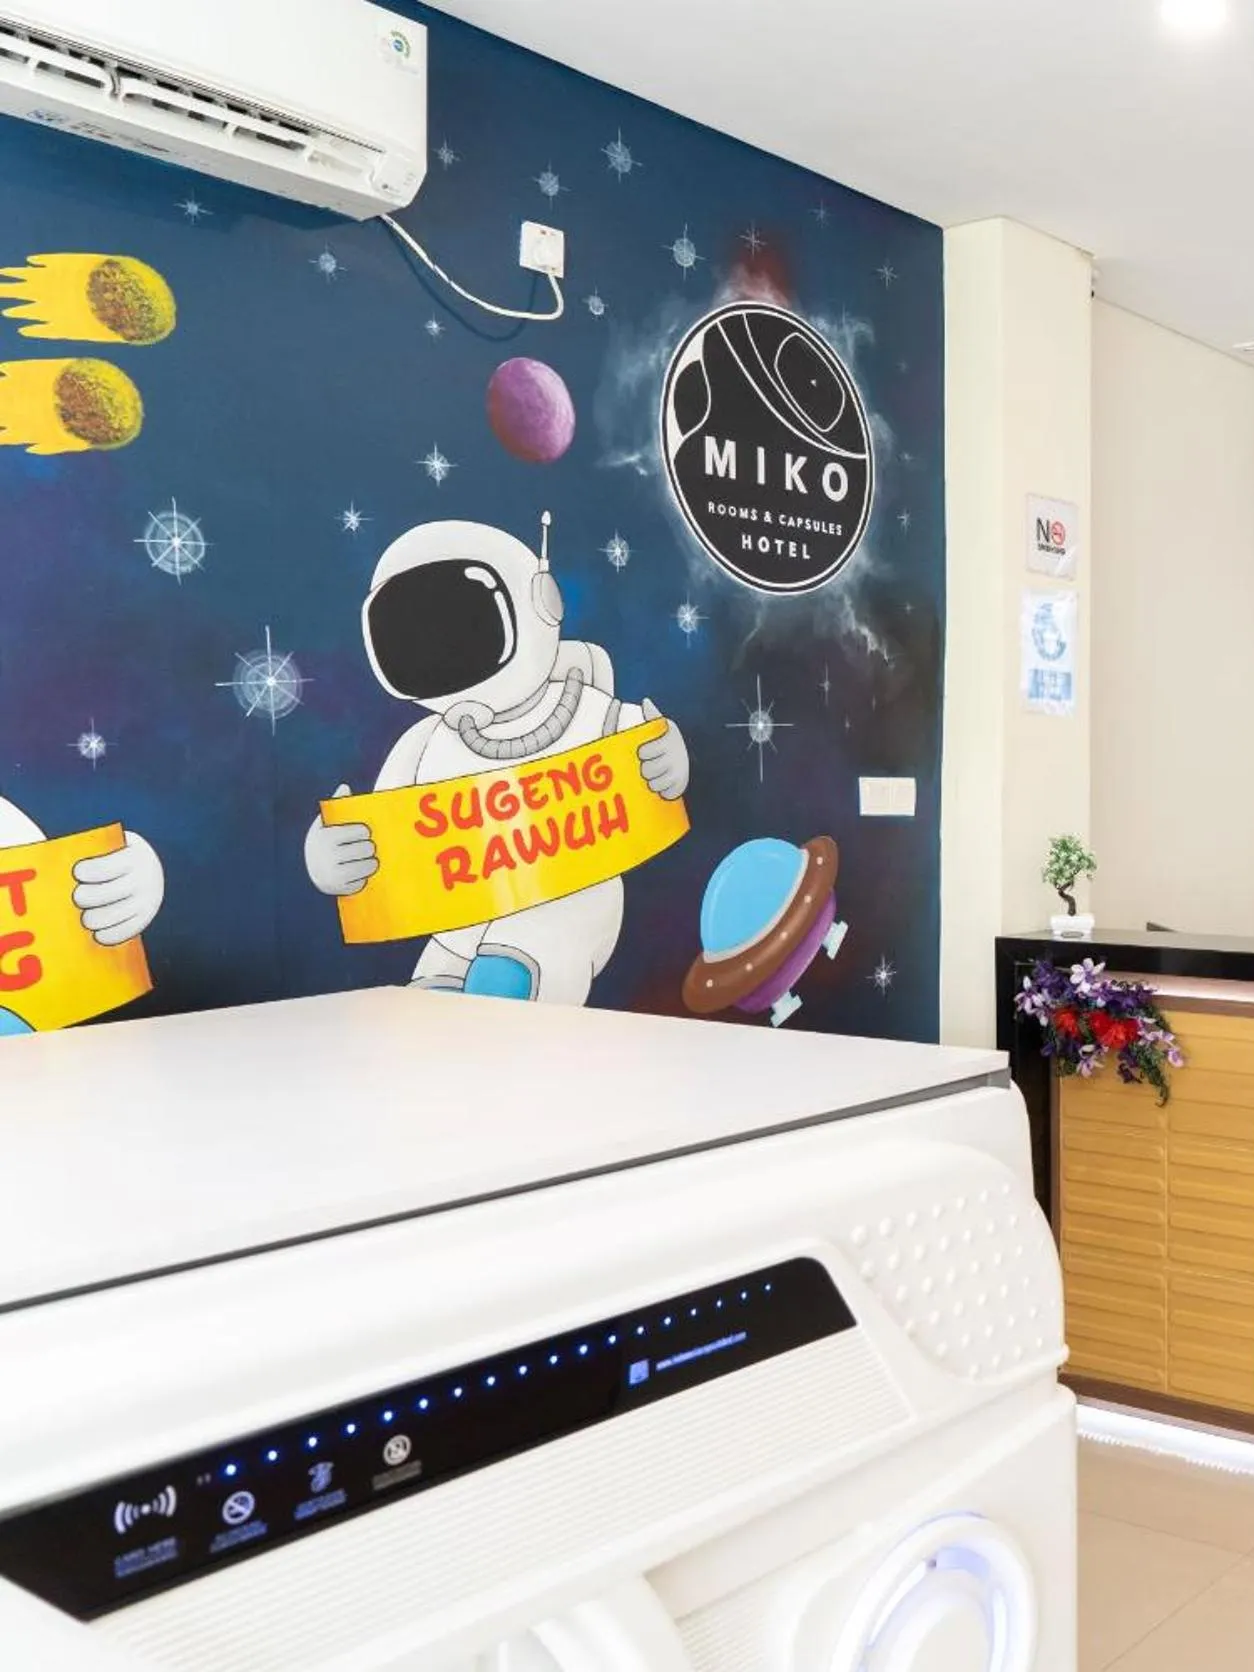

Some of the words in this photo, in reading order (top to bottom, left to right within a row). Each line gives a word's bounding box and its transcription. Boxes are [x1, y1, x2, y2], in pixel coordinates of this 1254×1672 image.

[704, 435, 848, 502] MIKO
[708, 501, 758, 522] ROOMS
[763, 510, 773, 524] &
[778, 513, 843, 537] CAPSULES
[741, 534, 810, 560] HOTEL
[414, 753, 614, 838] SUGENG
[435, 793, 630, 891] RAWUH
